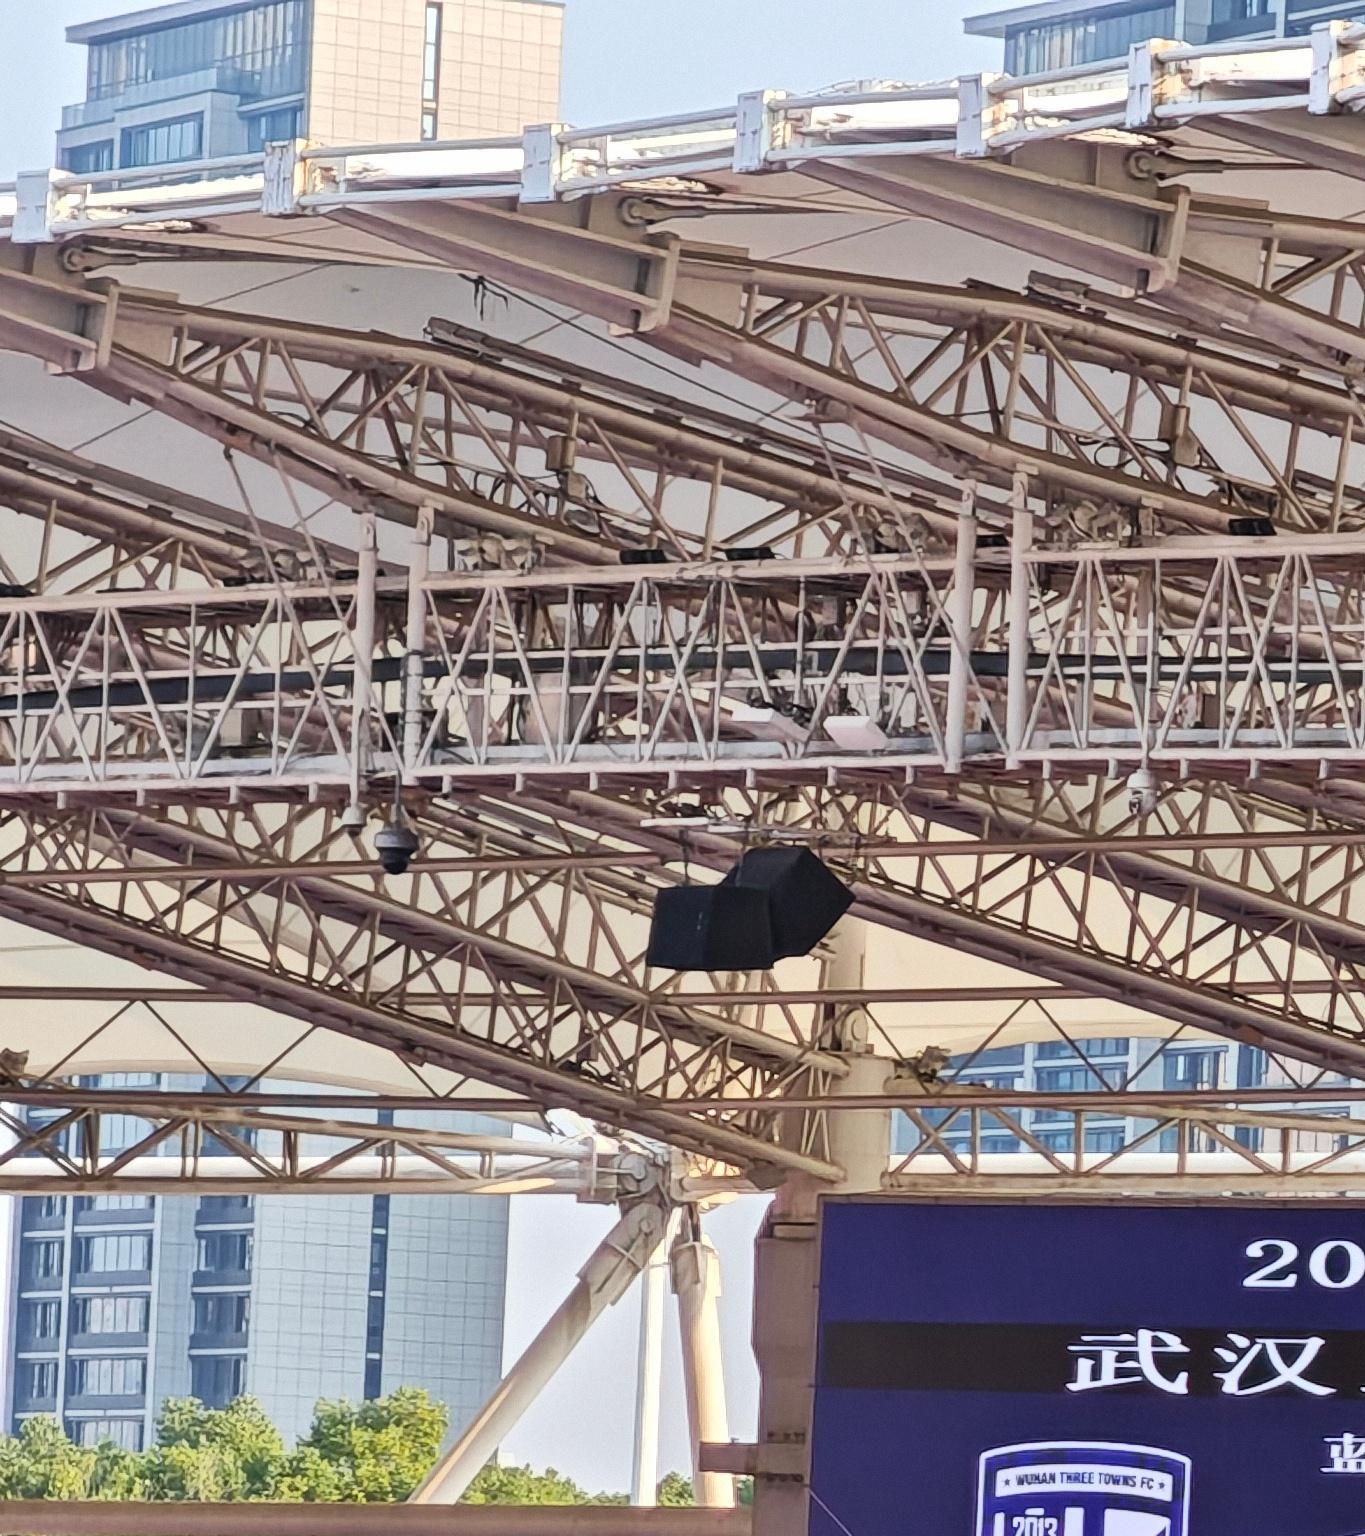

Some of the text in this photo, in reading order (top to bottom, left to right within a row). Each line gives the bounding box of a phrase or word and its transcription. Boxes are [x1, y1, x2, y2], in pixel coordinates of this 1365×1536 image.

[1016, 1471, 1154, 1490] WUHAN THREE TOWNS FC
